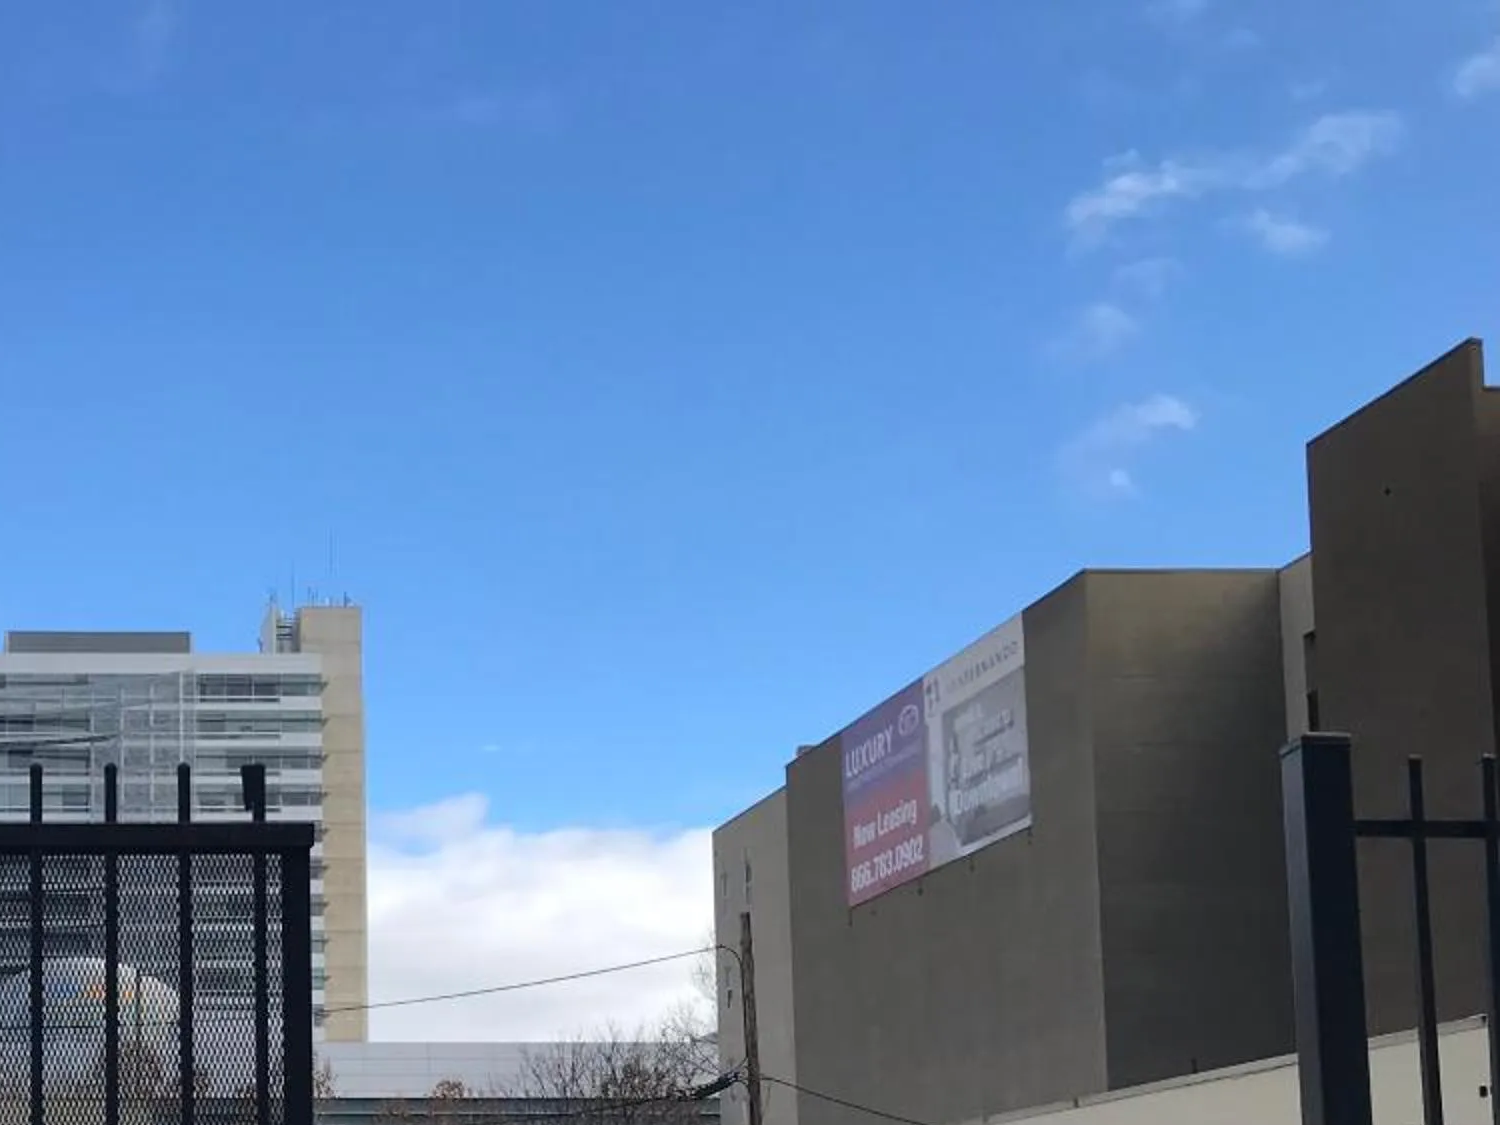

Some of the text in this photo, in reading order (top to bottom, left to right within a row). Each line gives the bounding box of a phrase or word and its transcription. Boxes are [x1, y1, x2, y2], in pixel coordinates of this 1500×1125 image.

[845, 724, 894, 778] LUXURY
[853, 799, 917, 850] Now Leasing
